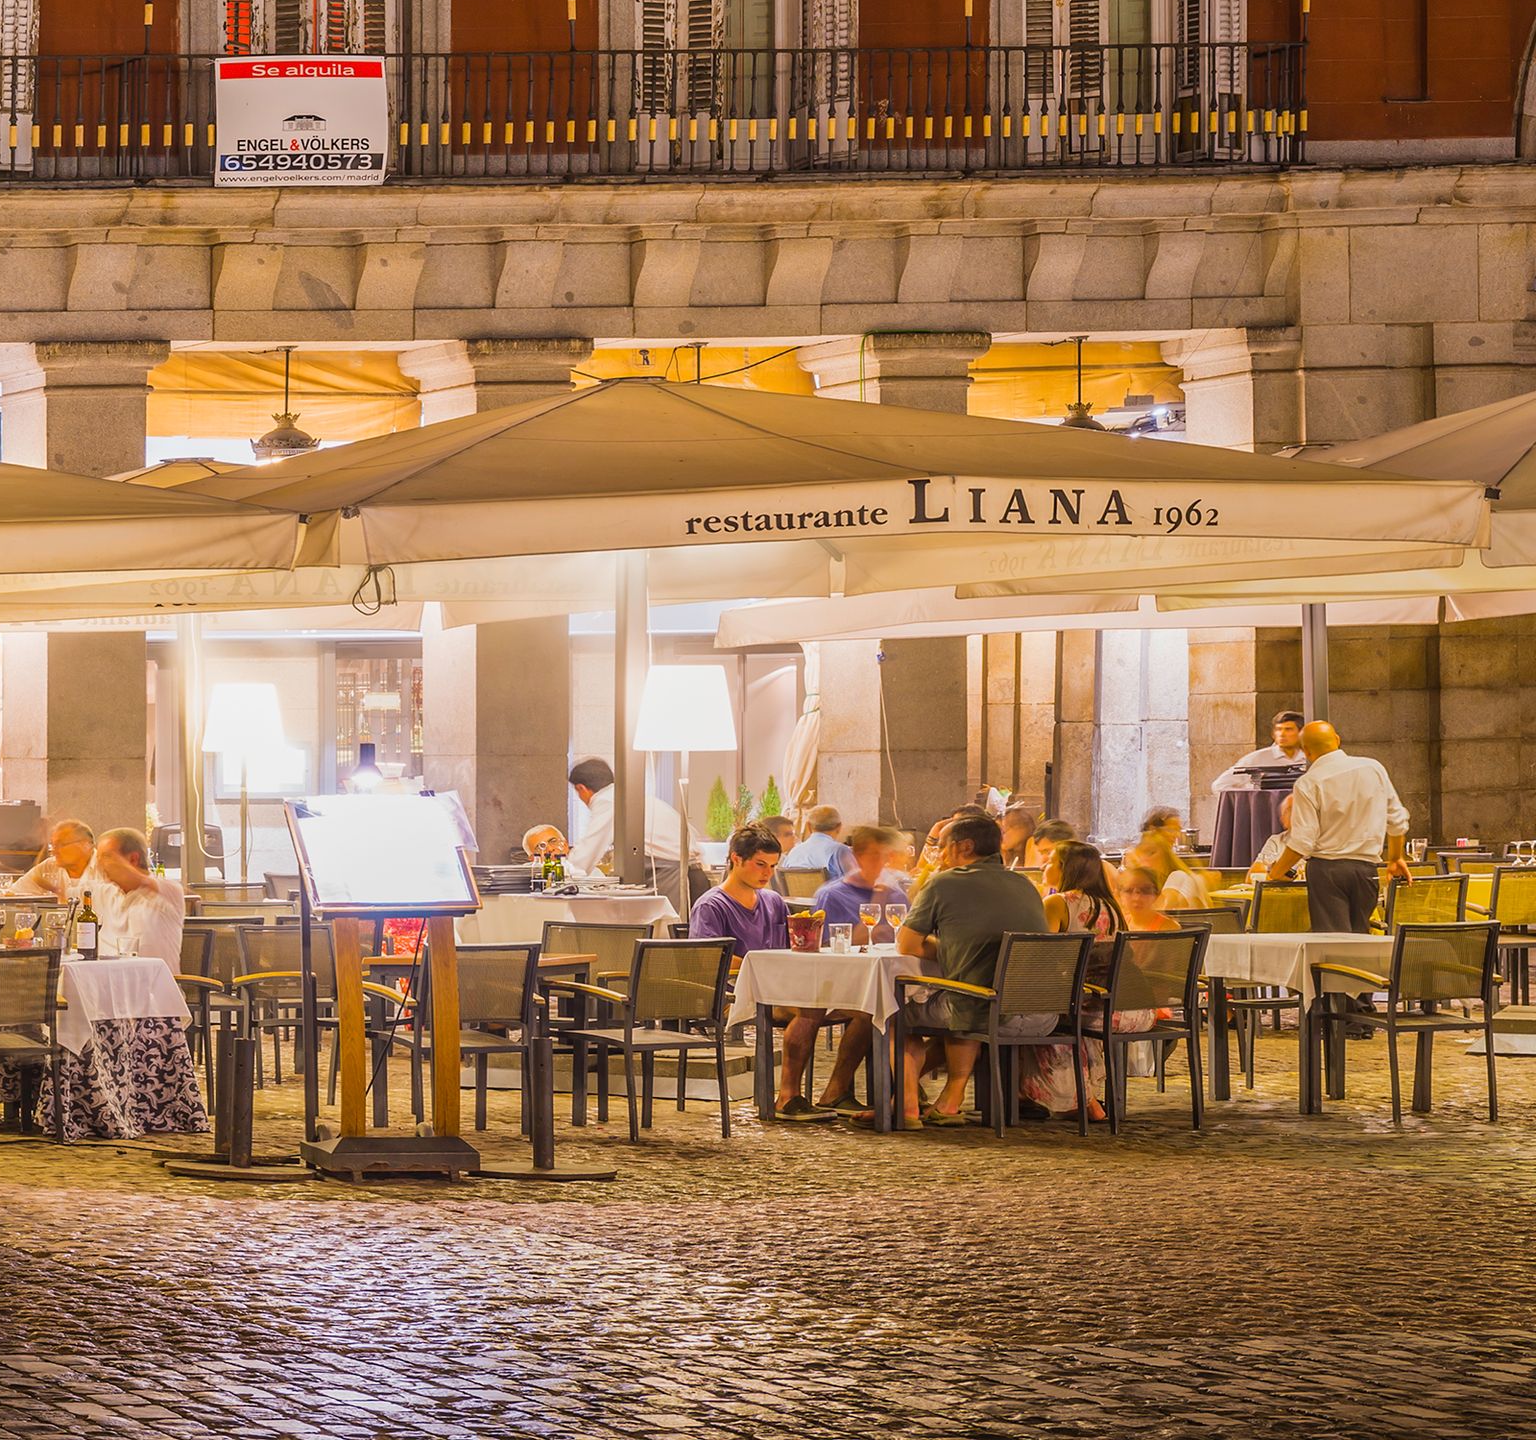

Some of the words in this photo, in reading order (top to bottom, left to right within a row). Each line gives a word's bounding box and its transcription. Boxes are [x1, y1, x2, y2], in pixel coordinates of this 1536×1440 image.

[251, 64, 280, 77] Se
[285, 63, 355, 79] alquila
[223, 154, 373, 171] 654940573
[219, 174, 380, 183] www.engelvoelkers.com/madrid
[685, 502, 889, 536] restaurante
[907, 478, 1134, 527] LIANA
[1153, 500, 1220, 534] 1962
